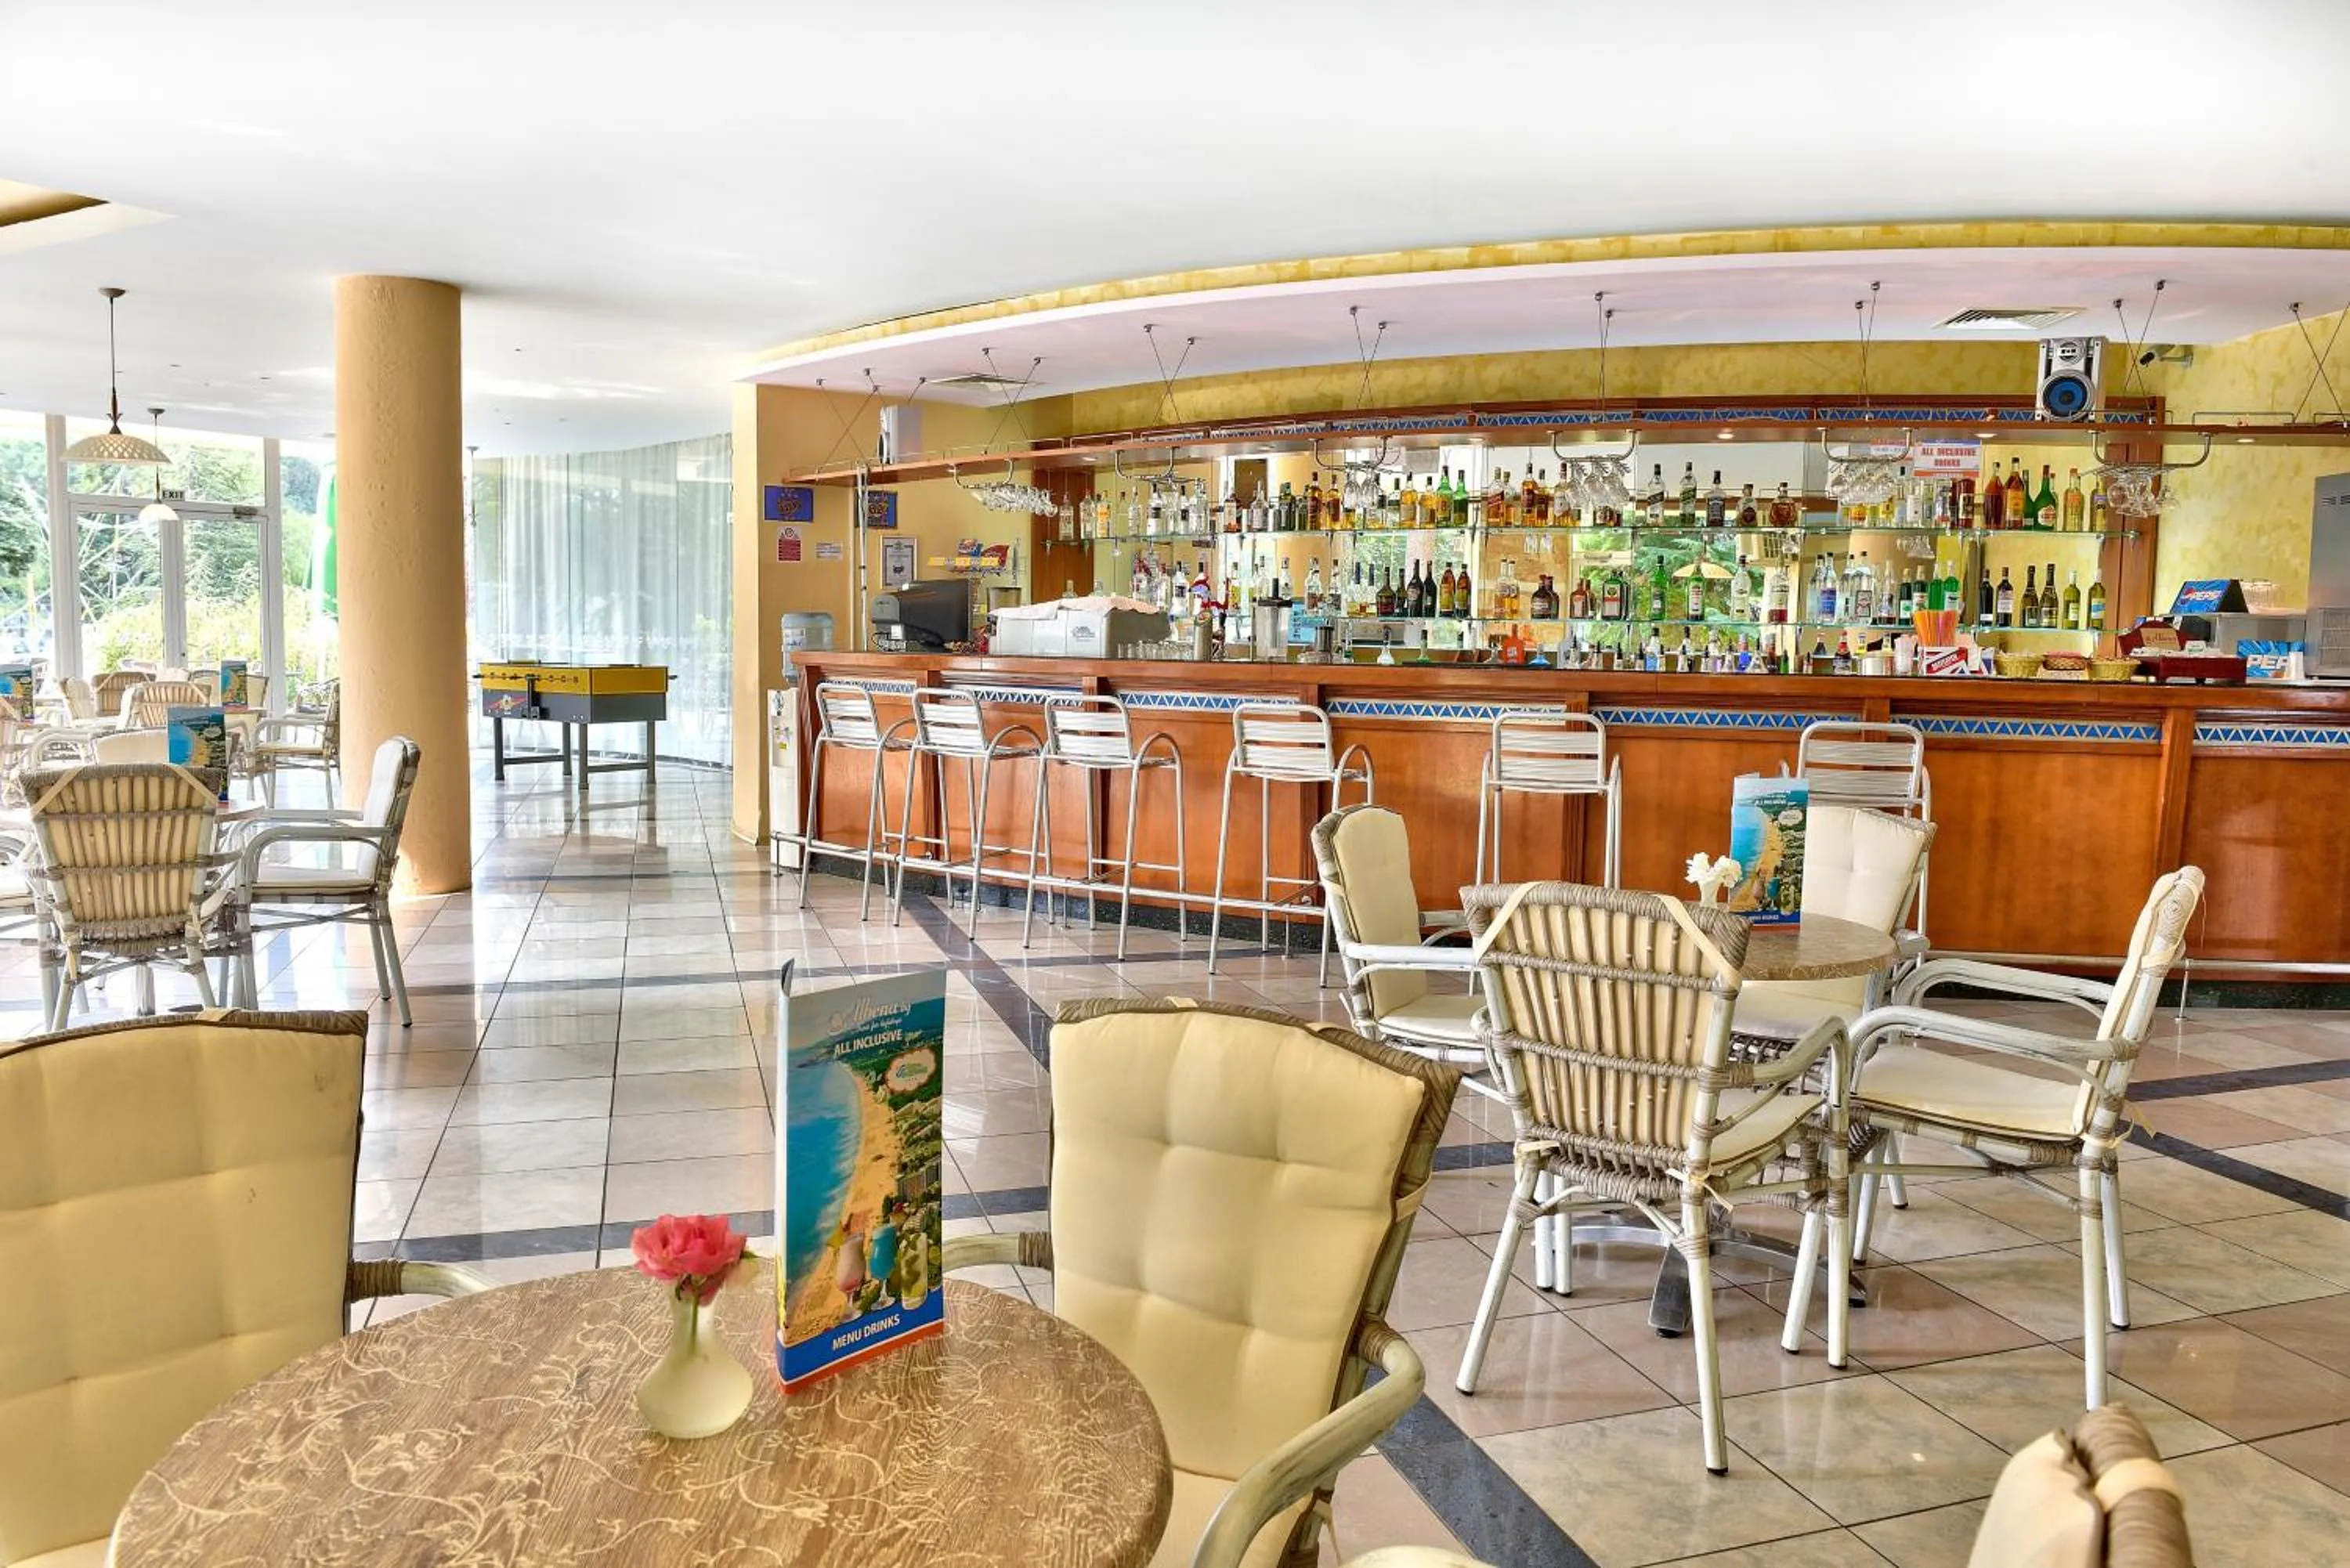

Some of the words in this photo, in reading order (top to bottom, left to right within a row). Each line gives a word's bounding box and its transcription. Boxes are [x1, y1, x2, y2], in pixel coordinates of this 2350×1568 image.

[162, 490, 184, 499] EXIT
[2190, 590, 2222, 601] PEPSI
[2246, 654, 2289, 671] PEP
[833, 1042, 851, 1057] ALL
[853, 1028, 903, 1051] INCLUSIVE
[832, 1328, 862, 1351] MENU
[863, 1313, 900, 1338] DRINKS
